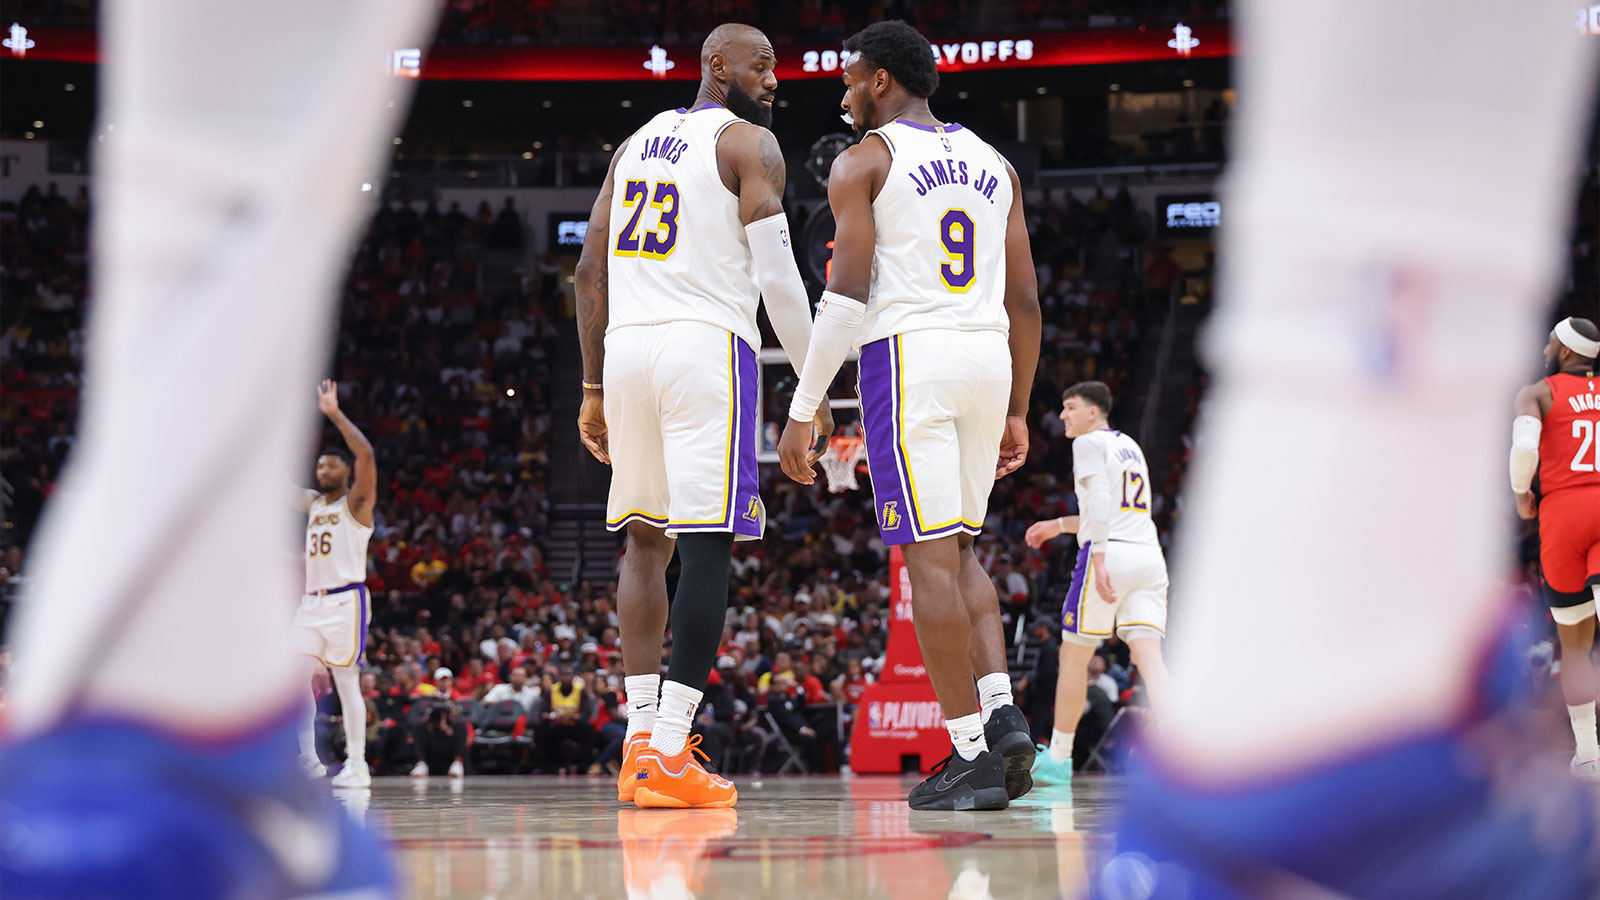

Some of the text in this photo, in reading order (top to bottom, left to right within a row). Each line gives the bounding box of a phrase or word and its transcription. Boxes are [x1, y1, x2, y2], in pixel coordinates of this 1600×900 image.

[641, 136, 688, 164] JAMES
[908, 159, 998, 204] JAMES JR.
[614, 179, 680, 261] 23
[939, 208, 977, 294] 9
[1571, 420, 1600, 472] 2
[1120, 470, 1148, 512] 12
[309, 531, 332, 559] 36
